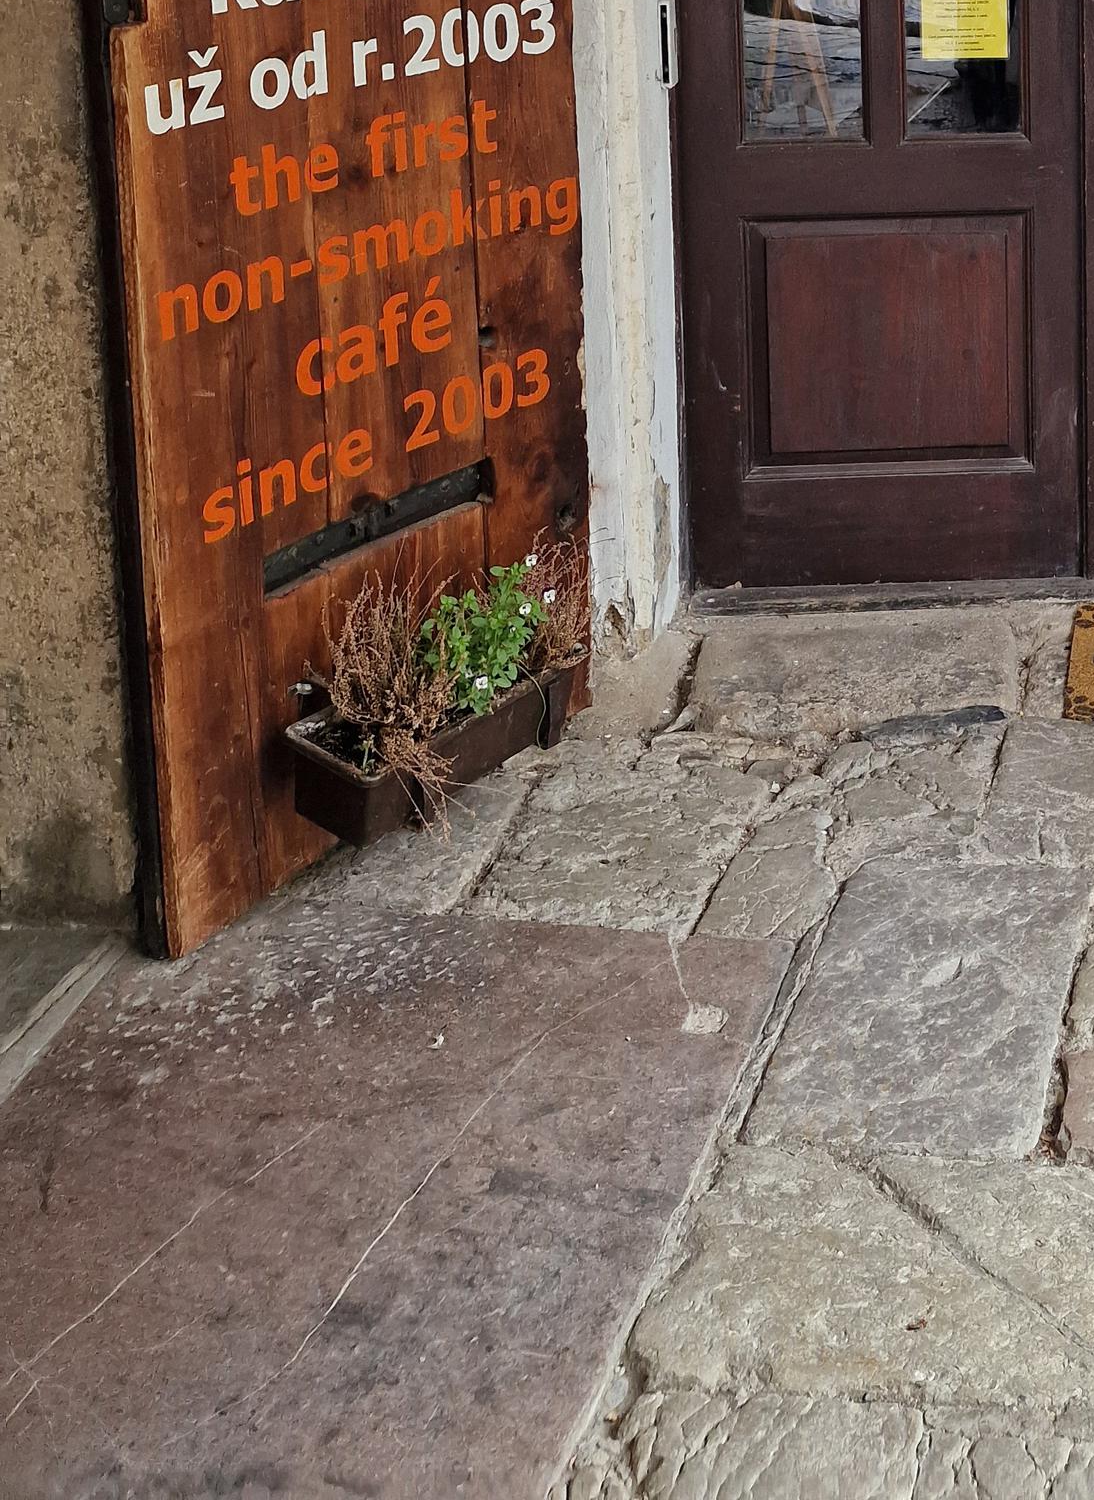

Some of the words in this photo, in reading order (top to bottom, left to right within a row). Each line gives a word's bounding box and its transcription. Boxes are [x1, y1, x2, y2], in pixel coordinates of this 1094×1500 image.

[144, 46, 225, 135] už
[250, 30, 329, 110] od
[229, 143, 339, 217] the
[365, 99, 498, 178] first
[154, 174, 579, 341] non-smoking
[295, 276, 453, 396] café
[203, 428, 374, 544] since
[403, 348, 550, 453] 2003
